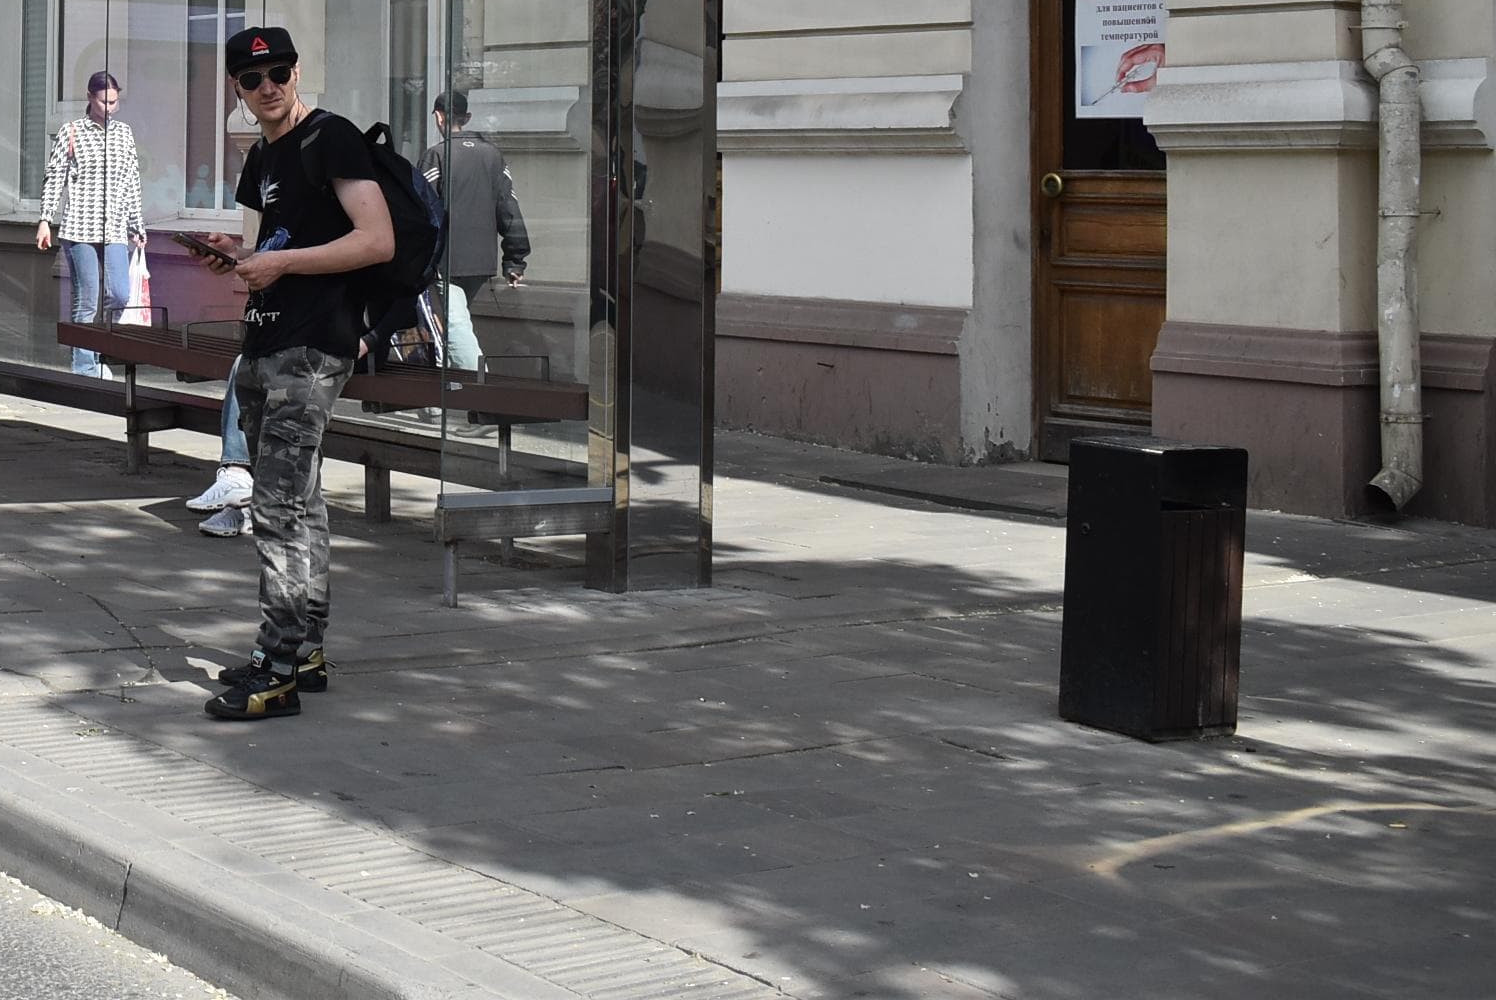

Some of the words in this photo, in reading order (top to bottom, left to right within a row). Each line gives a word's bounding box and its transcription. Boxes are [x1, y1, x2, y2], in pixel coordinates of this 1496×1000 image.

[1096, 5, 1110, 13] для
[1112, 3, 1157, 12] пациентов
[1102, 16, 1157, 26] повышенной
[1100, 31, 1159, 43] температурой
